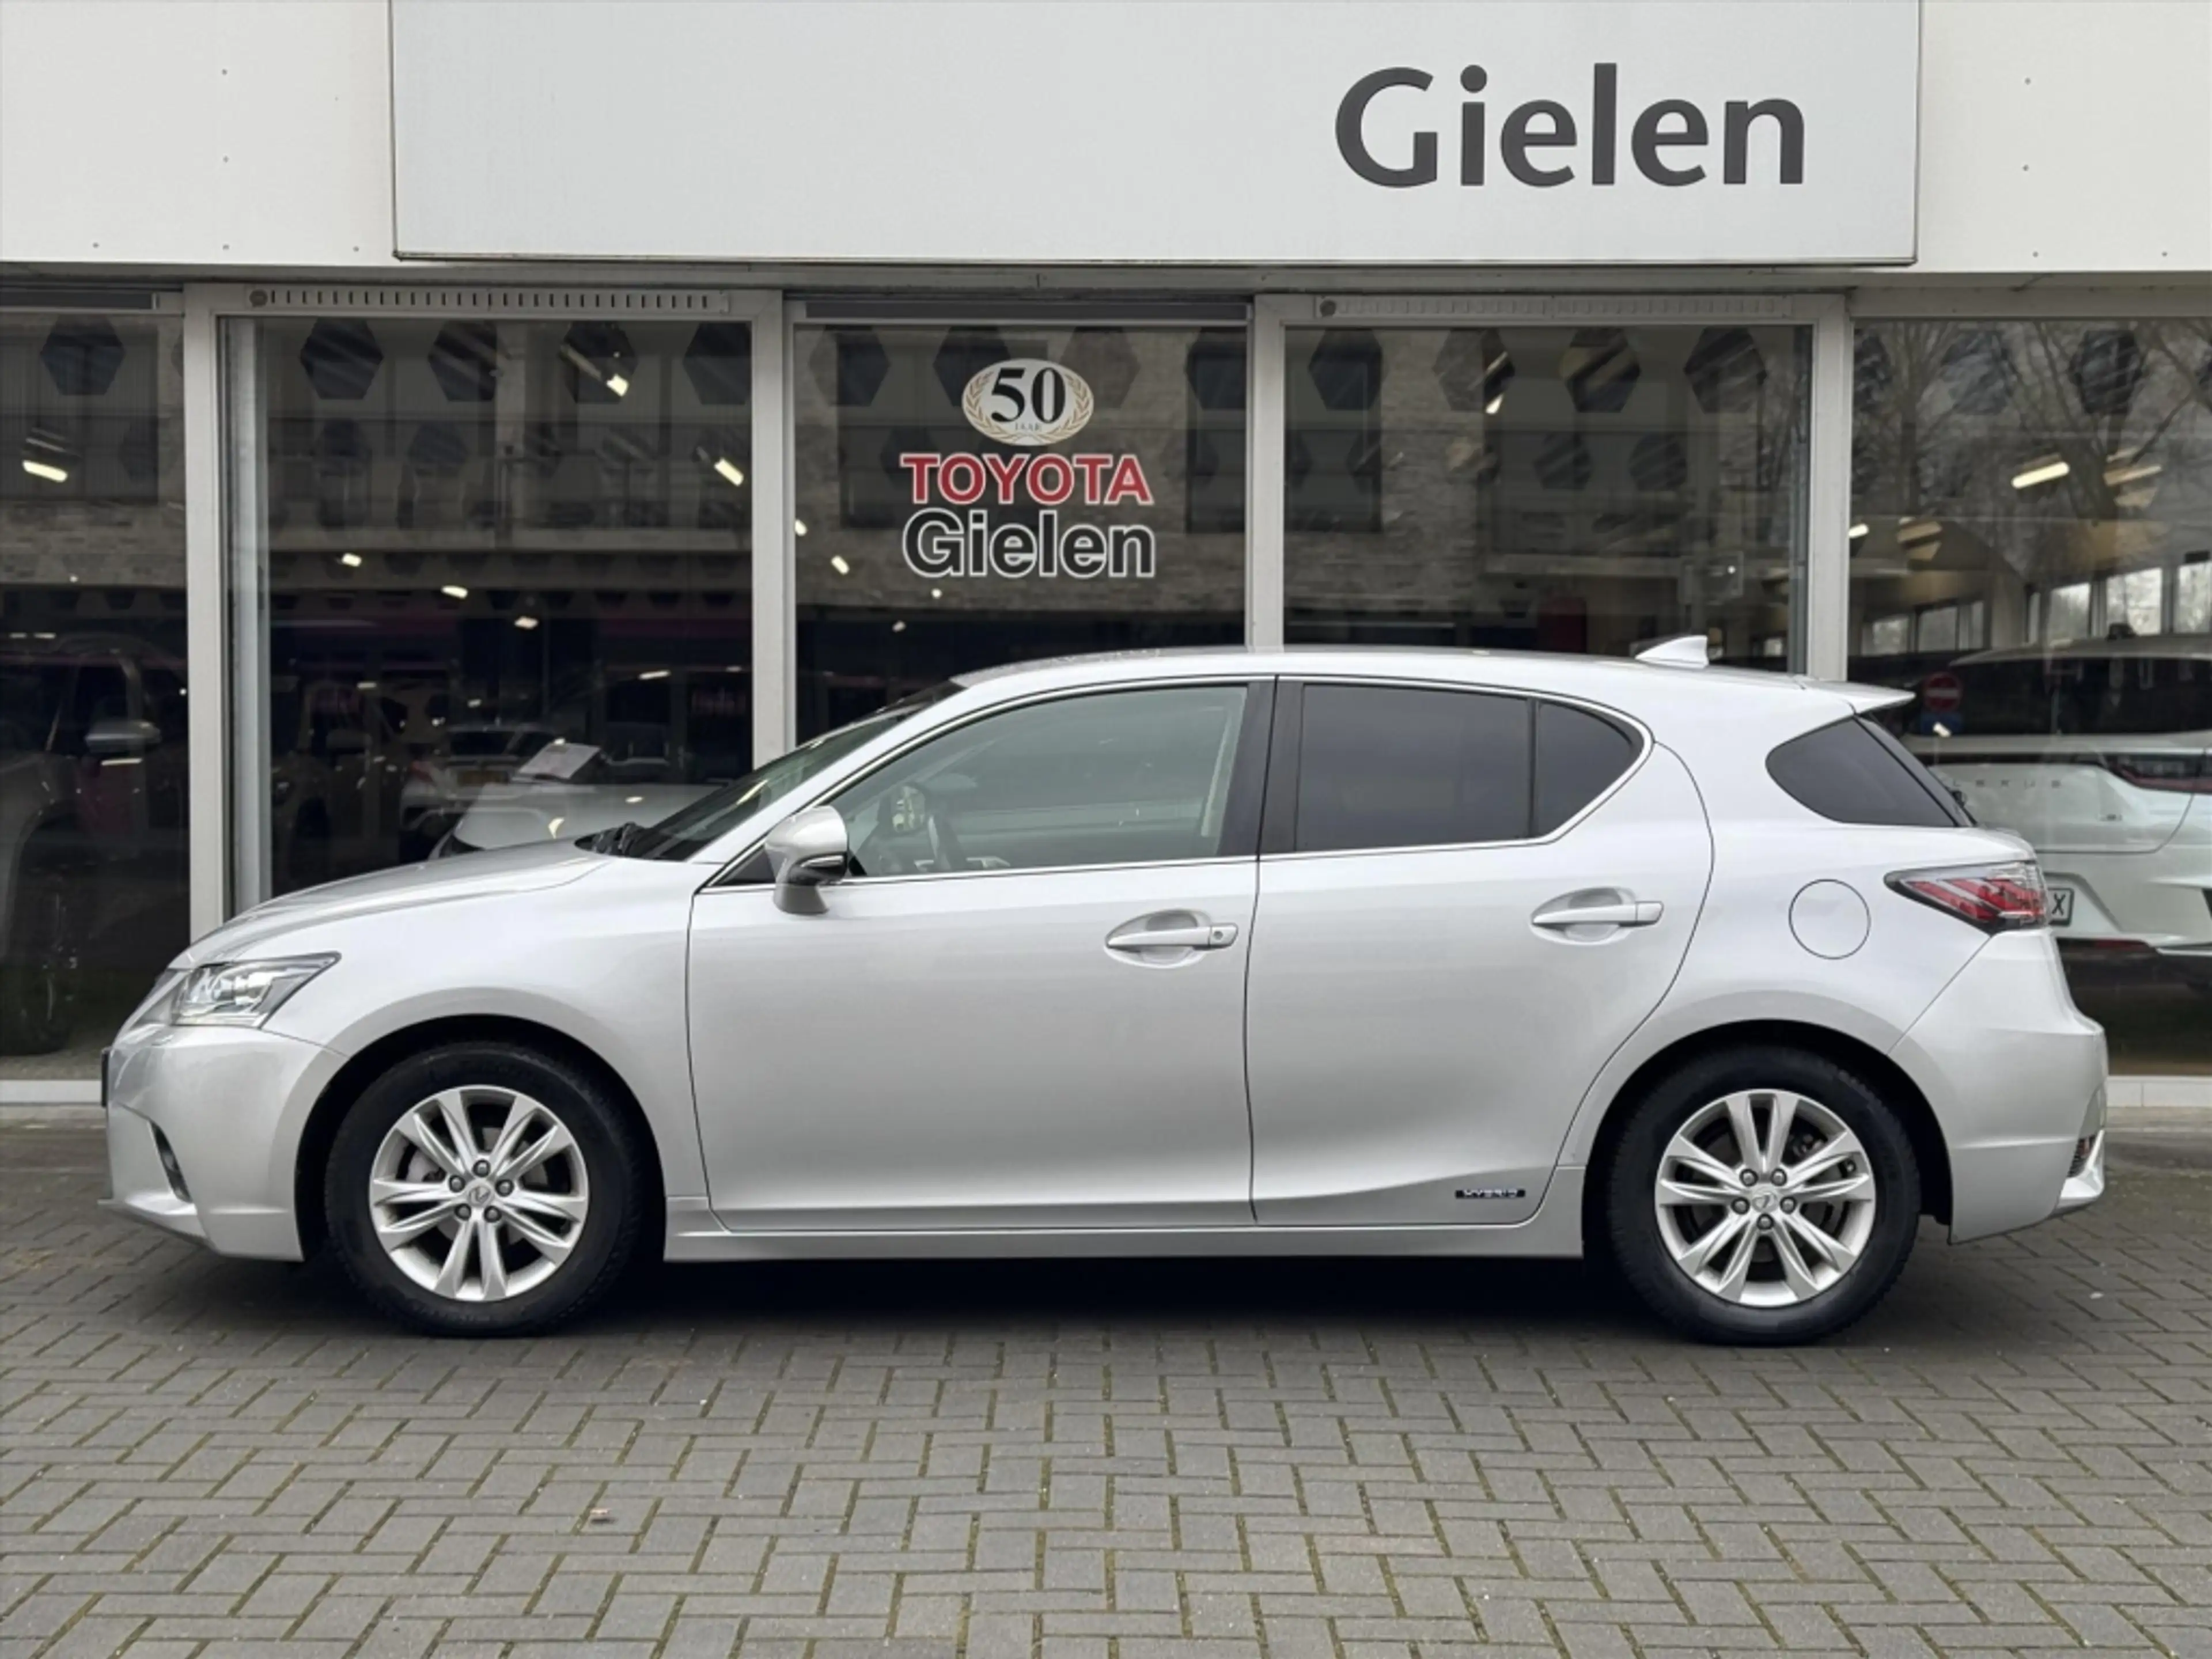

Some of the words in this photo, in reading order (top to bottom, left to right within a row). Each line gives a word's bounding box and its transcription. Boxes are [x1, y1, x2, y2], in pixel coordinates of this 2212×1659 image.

[1335, 63, 1805, 188] Gielen
[991, 367, 1066, 423] 50
[900, 452, 1154, 505] TOYOTA
[903, 507, 1156, 578] Gielen
